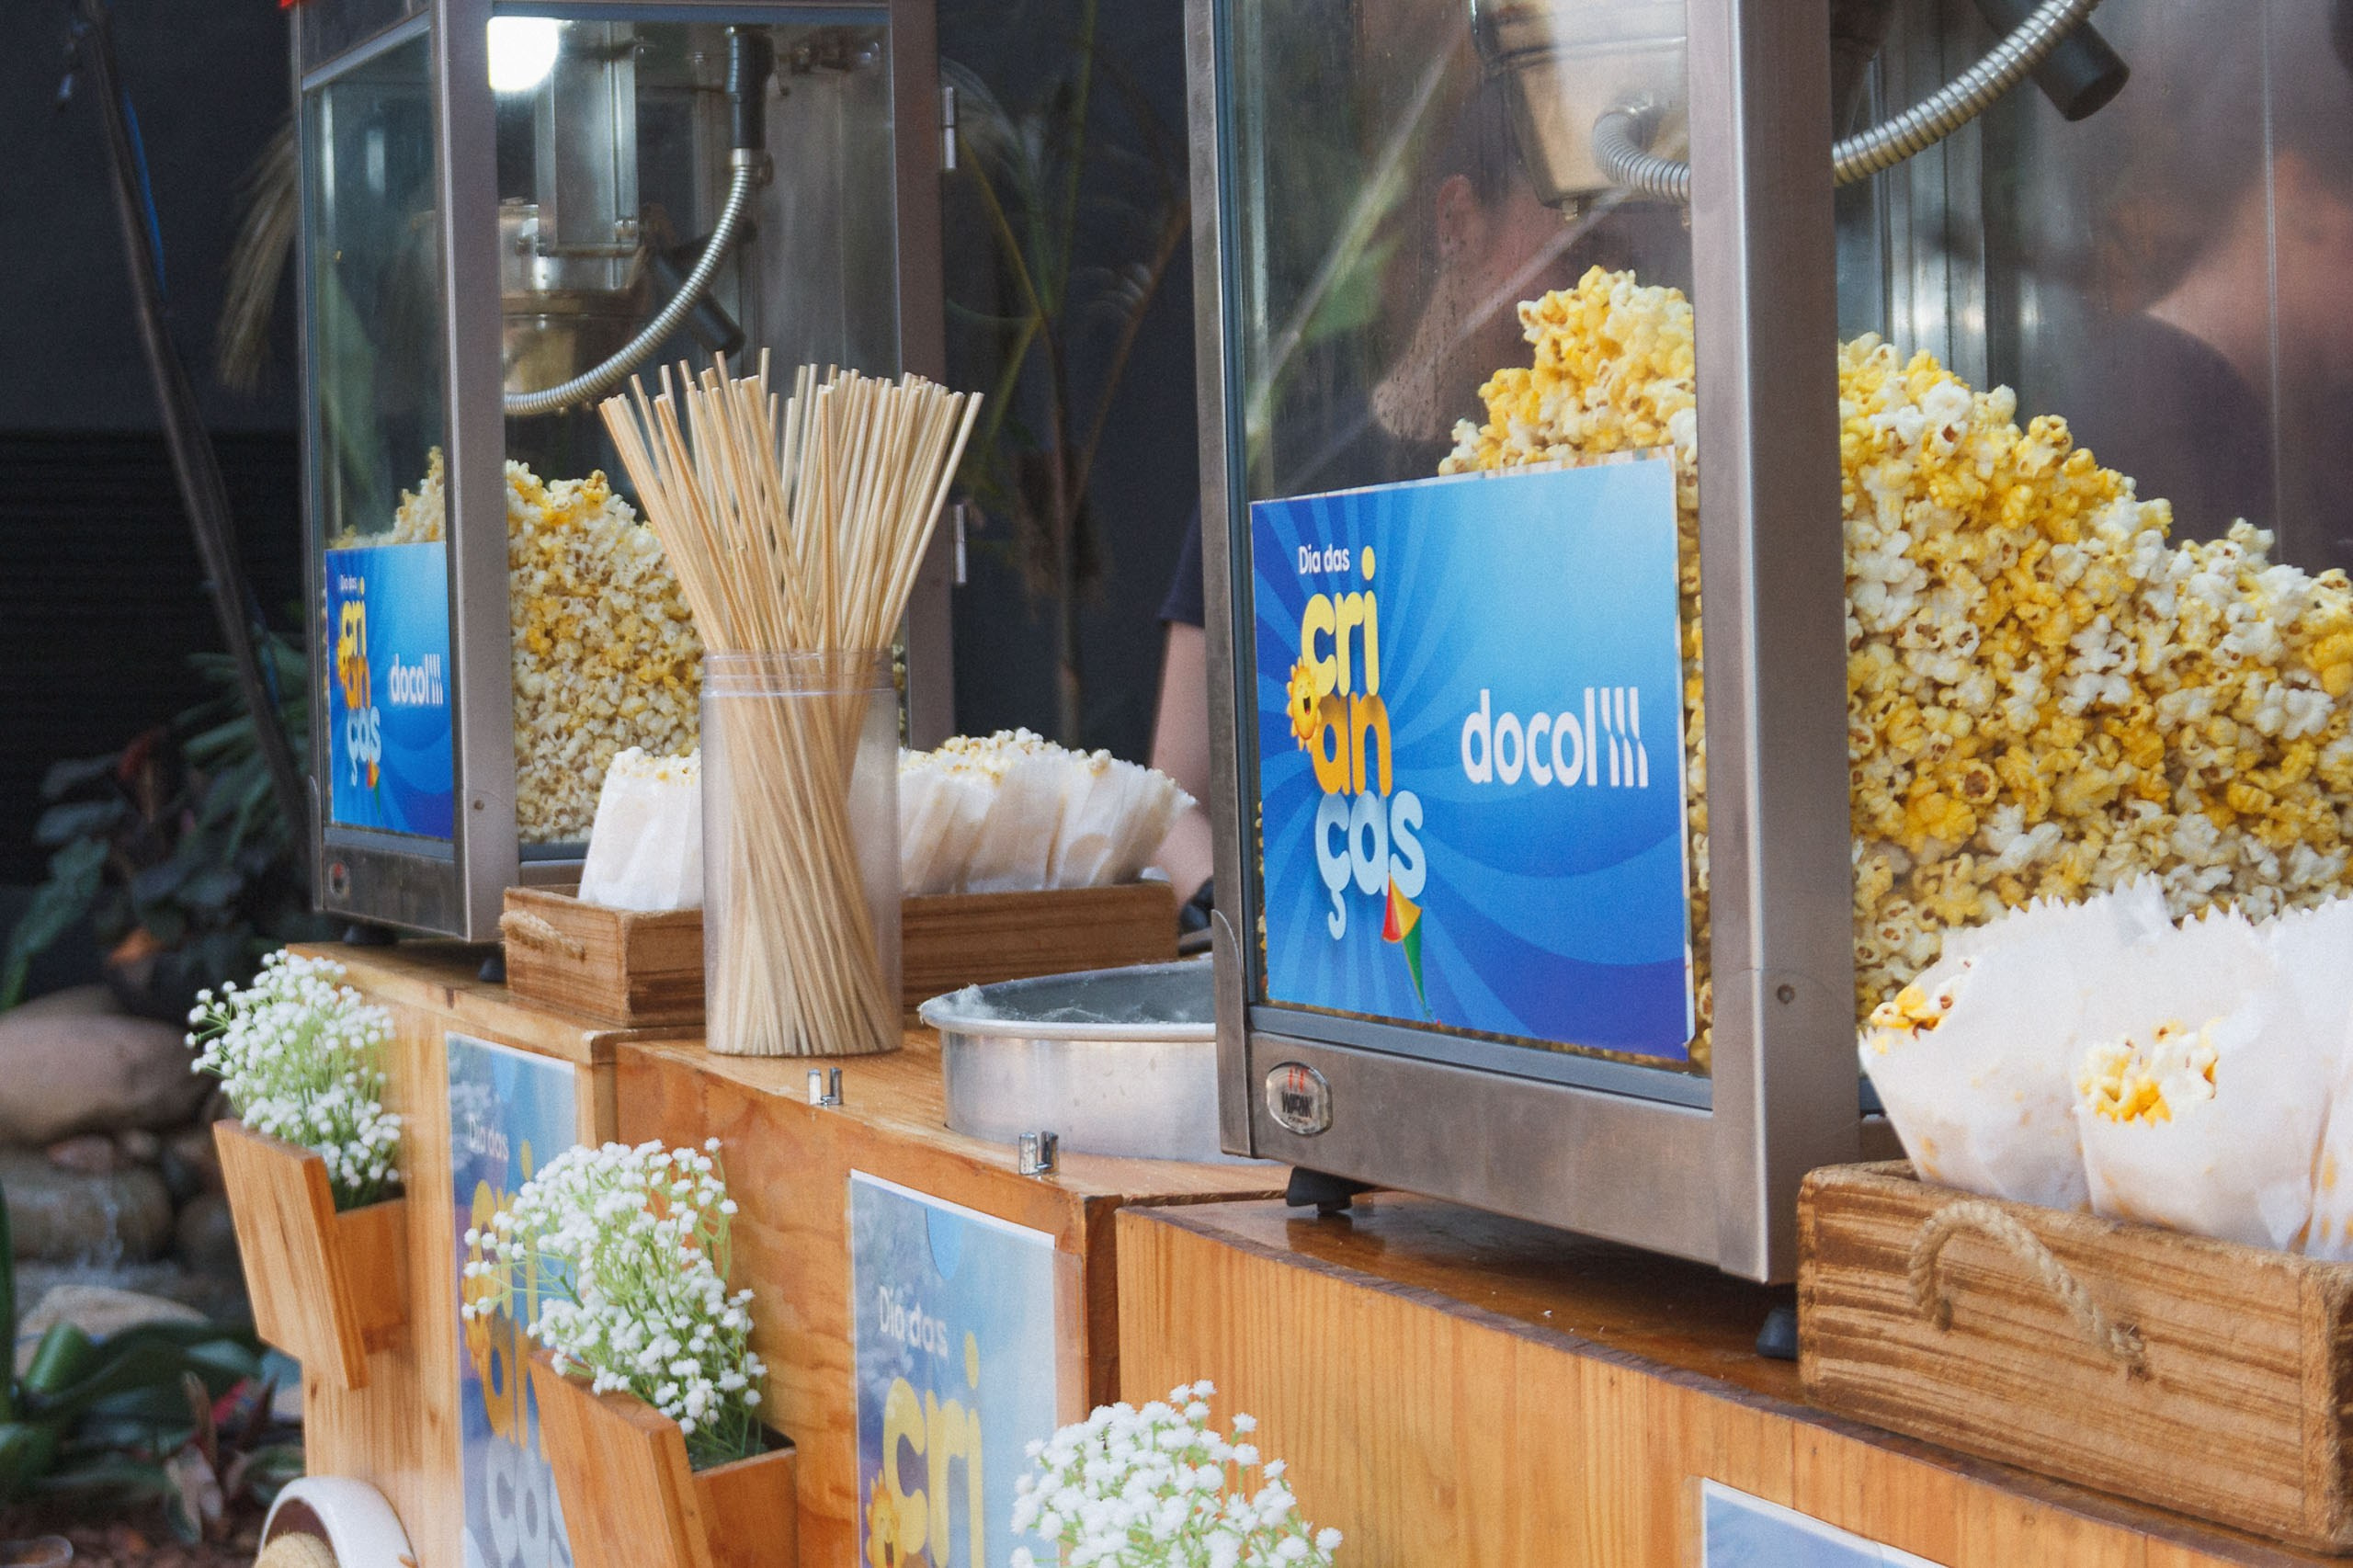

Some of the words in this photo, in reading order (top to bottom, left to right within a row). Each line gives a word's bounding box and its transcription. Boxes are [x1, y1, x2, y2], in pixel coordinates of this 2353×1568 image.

[1299, 544, 1321, 574] Dia
[1324, 543, 1350, 573] das
[1302, 545, 1380, 697] cri
[1461, 687, 1597, 788] docol
[880, 1285, 904, 1341] Dia
[909, 1301, 948, 1358] das
